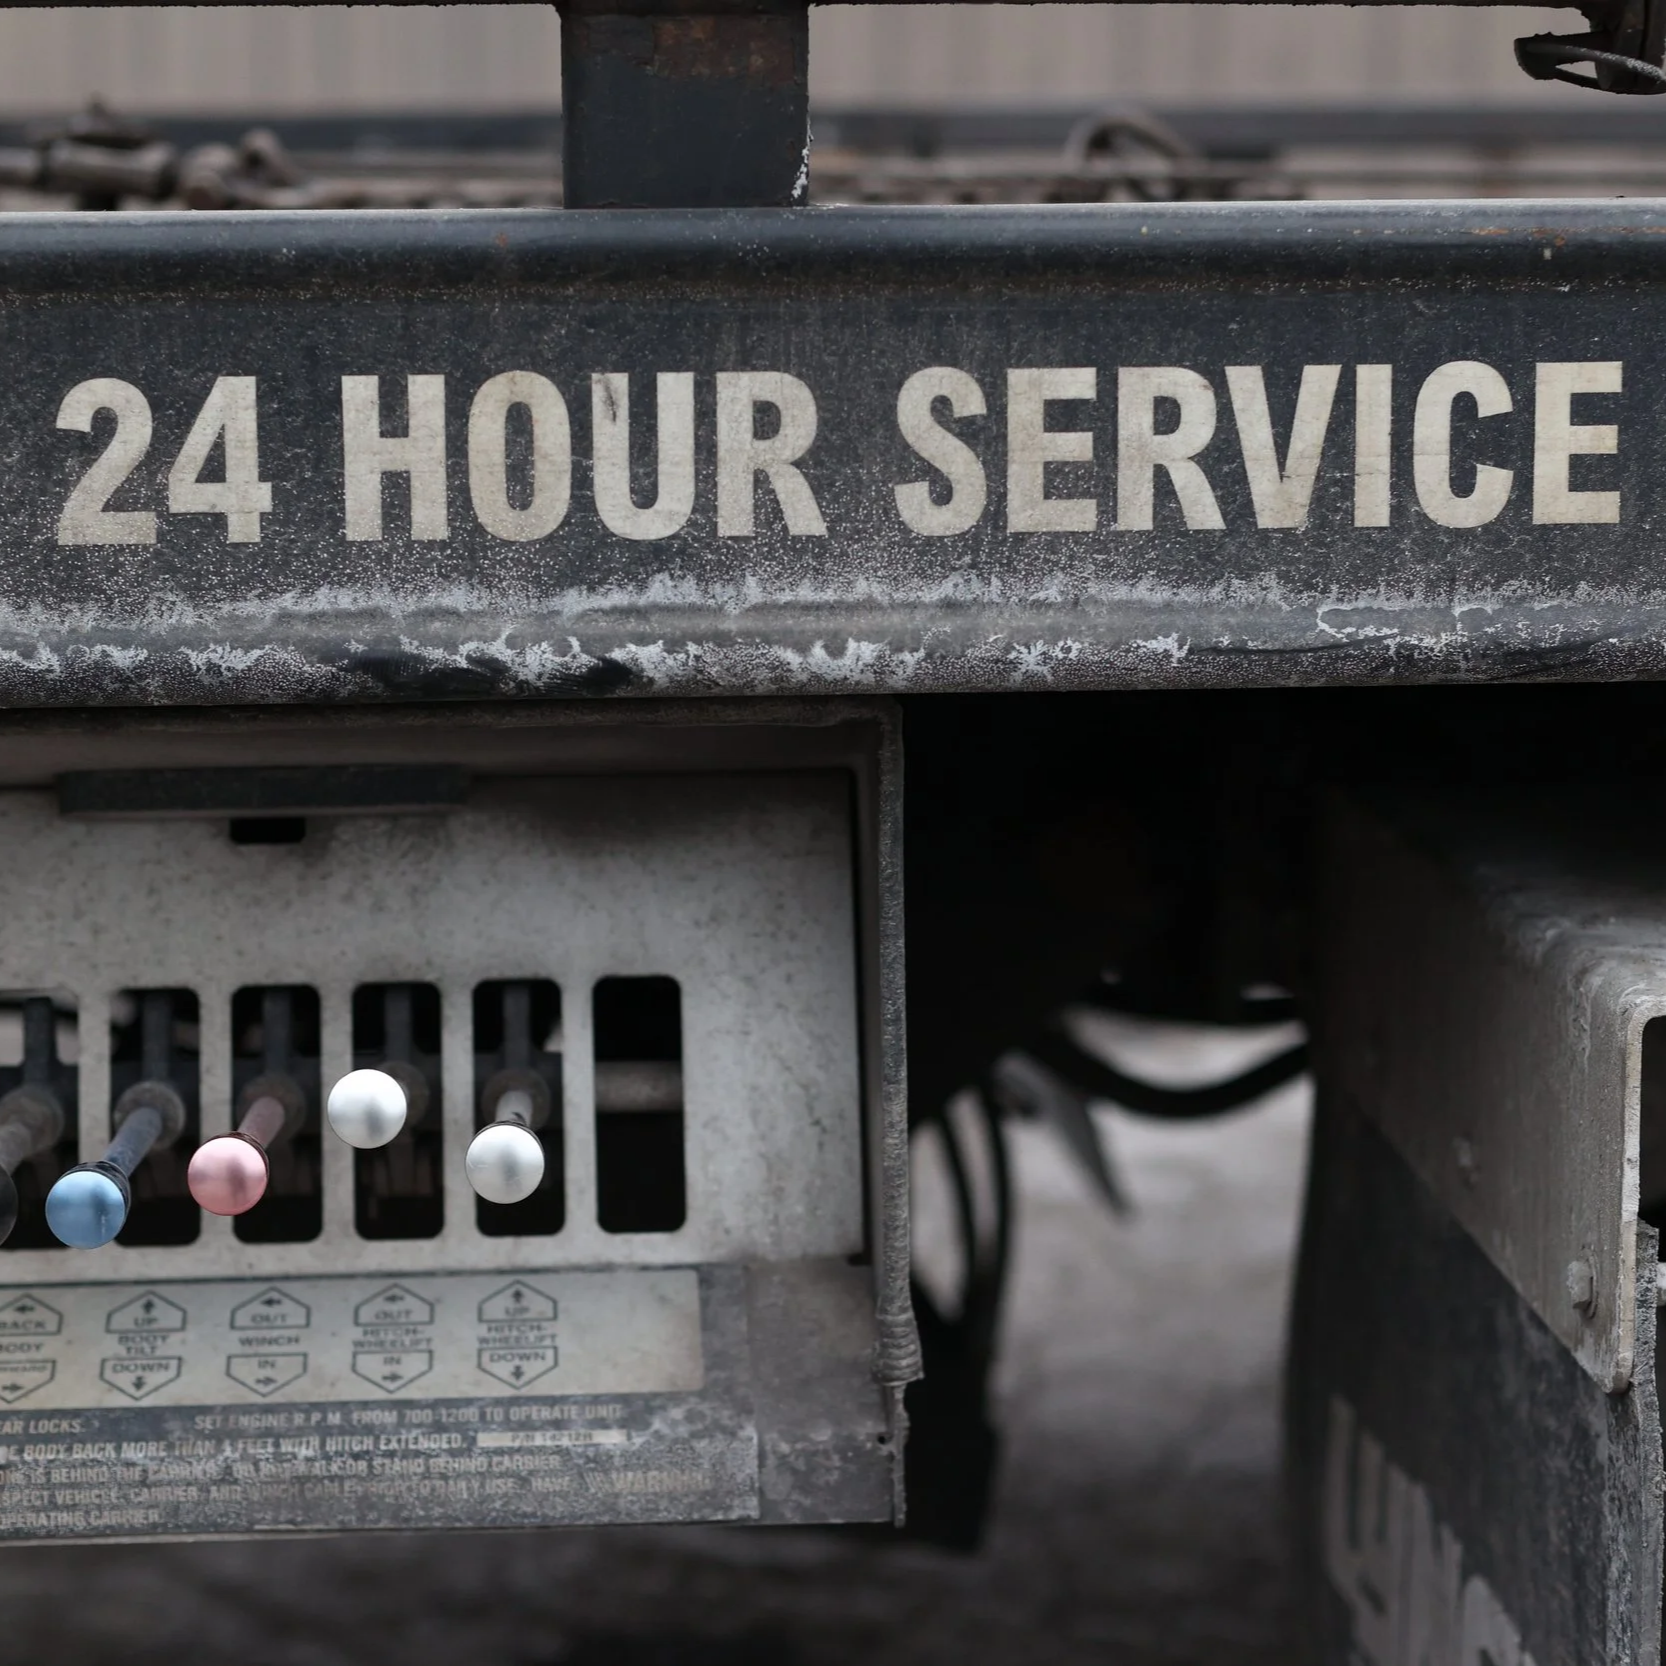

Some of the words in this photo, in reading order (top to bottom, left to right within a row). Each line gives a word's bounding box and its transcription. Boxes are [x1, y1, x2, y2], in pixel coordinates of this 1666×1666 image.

[55, 376, 273, 546] 24
[341, 370, 828, 542] HOUR
[894, 360, 1624, 537] SERVICE
[374, 1308, 412, 1321] OUT
[504, 1305, 530, 1317] UP
[133, 1317, 158, 1328] UP
[251, 1313, 288, 1324] OUT
[118, 1334, 169, 1346] BODY
[239, 1335, 300, 1347] WINCH
[125, 1345, 158, 1356] TILT
[383, 1355, 403, 1366] IN
[489, 1351, 546, 1363] DOWN
[112, 1362, 170, 1374] DOWN
[257, 1359, 277, 1369] IN
[194, 1415, 222, 1430] SET
[228, 1412, 289, 1429] ENGINE
[352, 1408, 398, 1425] FROM
[484, 1406, 504, 1421] TO
[509, 1404, 579, 1421] OPERATE
[23, 1443, 70, 1461] BODY
[71, 1442, 117, 1460] BACK
[120, 1440, 167, 1459] MORE
[174, 1438, 216, 1457] THAN
[279, 1436, 320, 1454] WITH
[325, 1435, 375, 1452] HITCH
